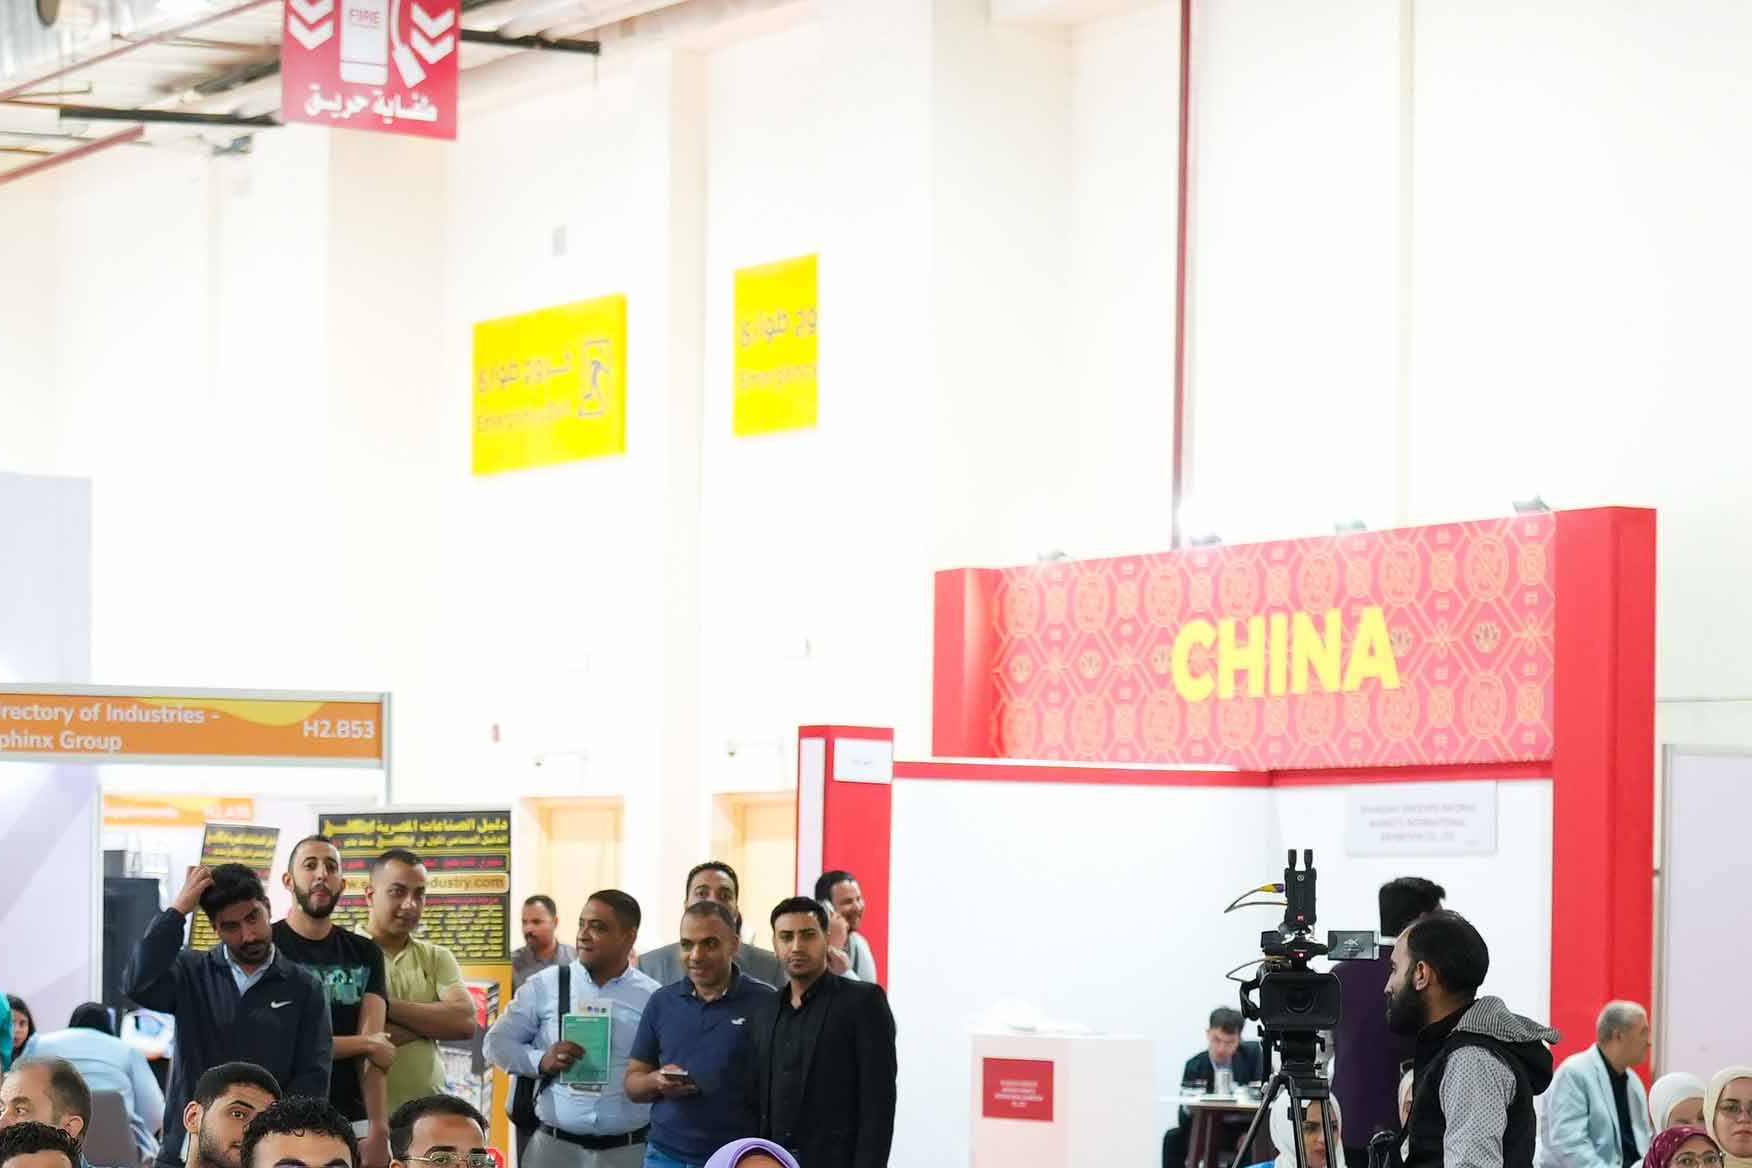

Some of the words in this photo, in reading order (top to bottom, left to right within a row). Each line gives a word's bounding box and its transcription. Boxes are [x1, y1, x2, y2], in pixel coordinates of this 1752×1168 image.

[349, 9, 381, 25] FIRE
[305, 82, 371, 119] حريق
[1171, 606, 1401, 702] CHINA
[80, 704, 102, 723] of
[106, 704, 205, 724] Industries
[302, 719, 376, 739] H2.B53
[59, 730, 123, 753] Group
[376, 817, 418, 836] المصرية
[419, 817, 476, 832] الصناعات
[477, 815, 509, 835] دليل
